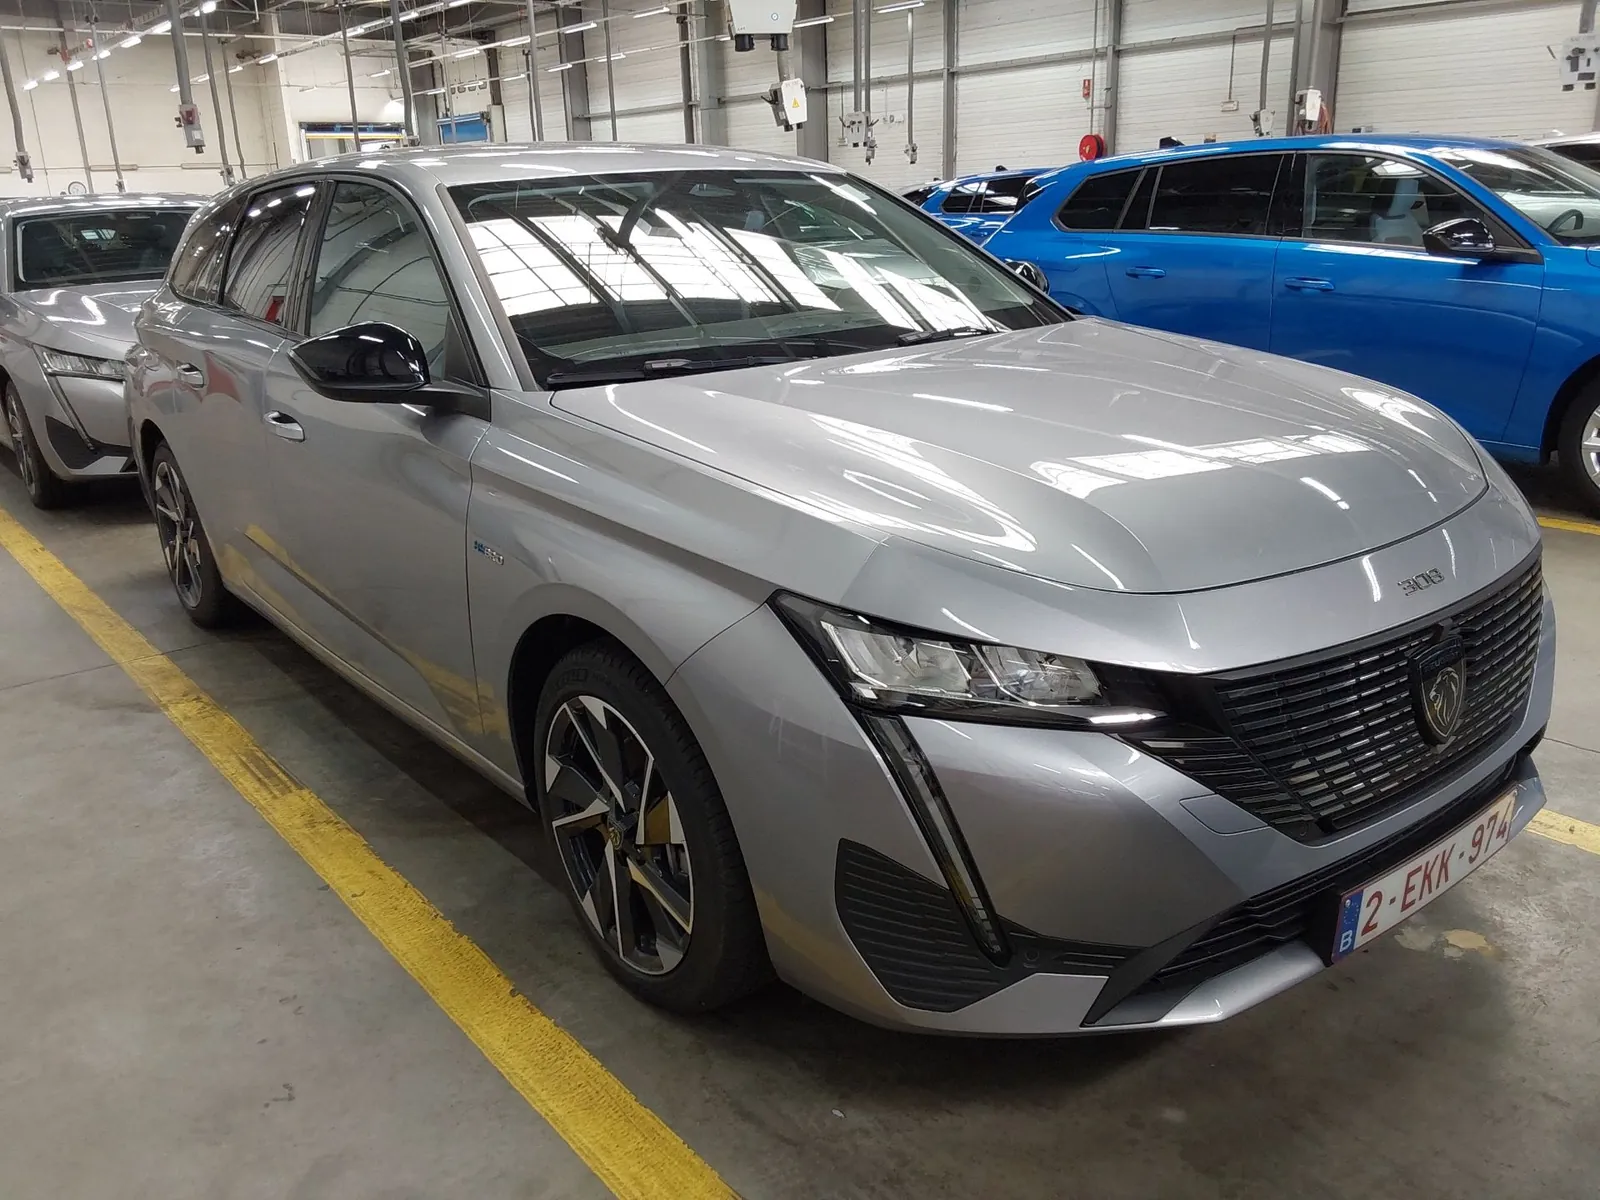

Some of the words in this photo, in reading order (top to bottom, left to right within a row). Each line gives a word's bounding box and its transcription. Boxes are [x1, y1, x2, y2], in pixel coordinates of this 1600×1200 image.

[1397, 567, 1445, 597] 308
[1361, 799, 1512, 937] 2-EKK-974
[1339, 929, 1353, 953] B
